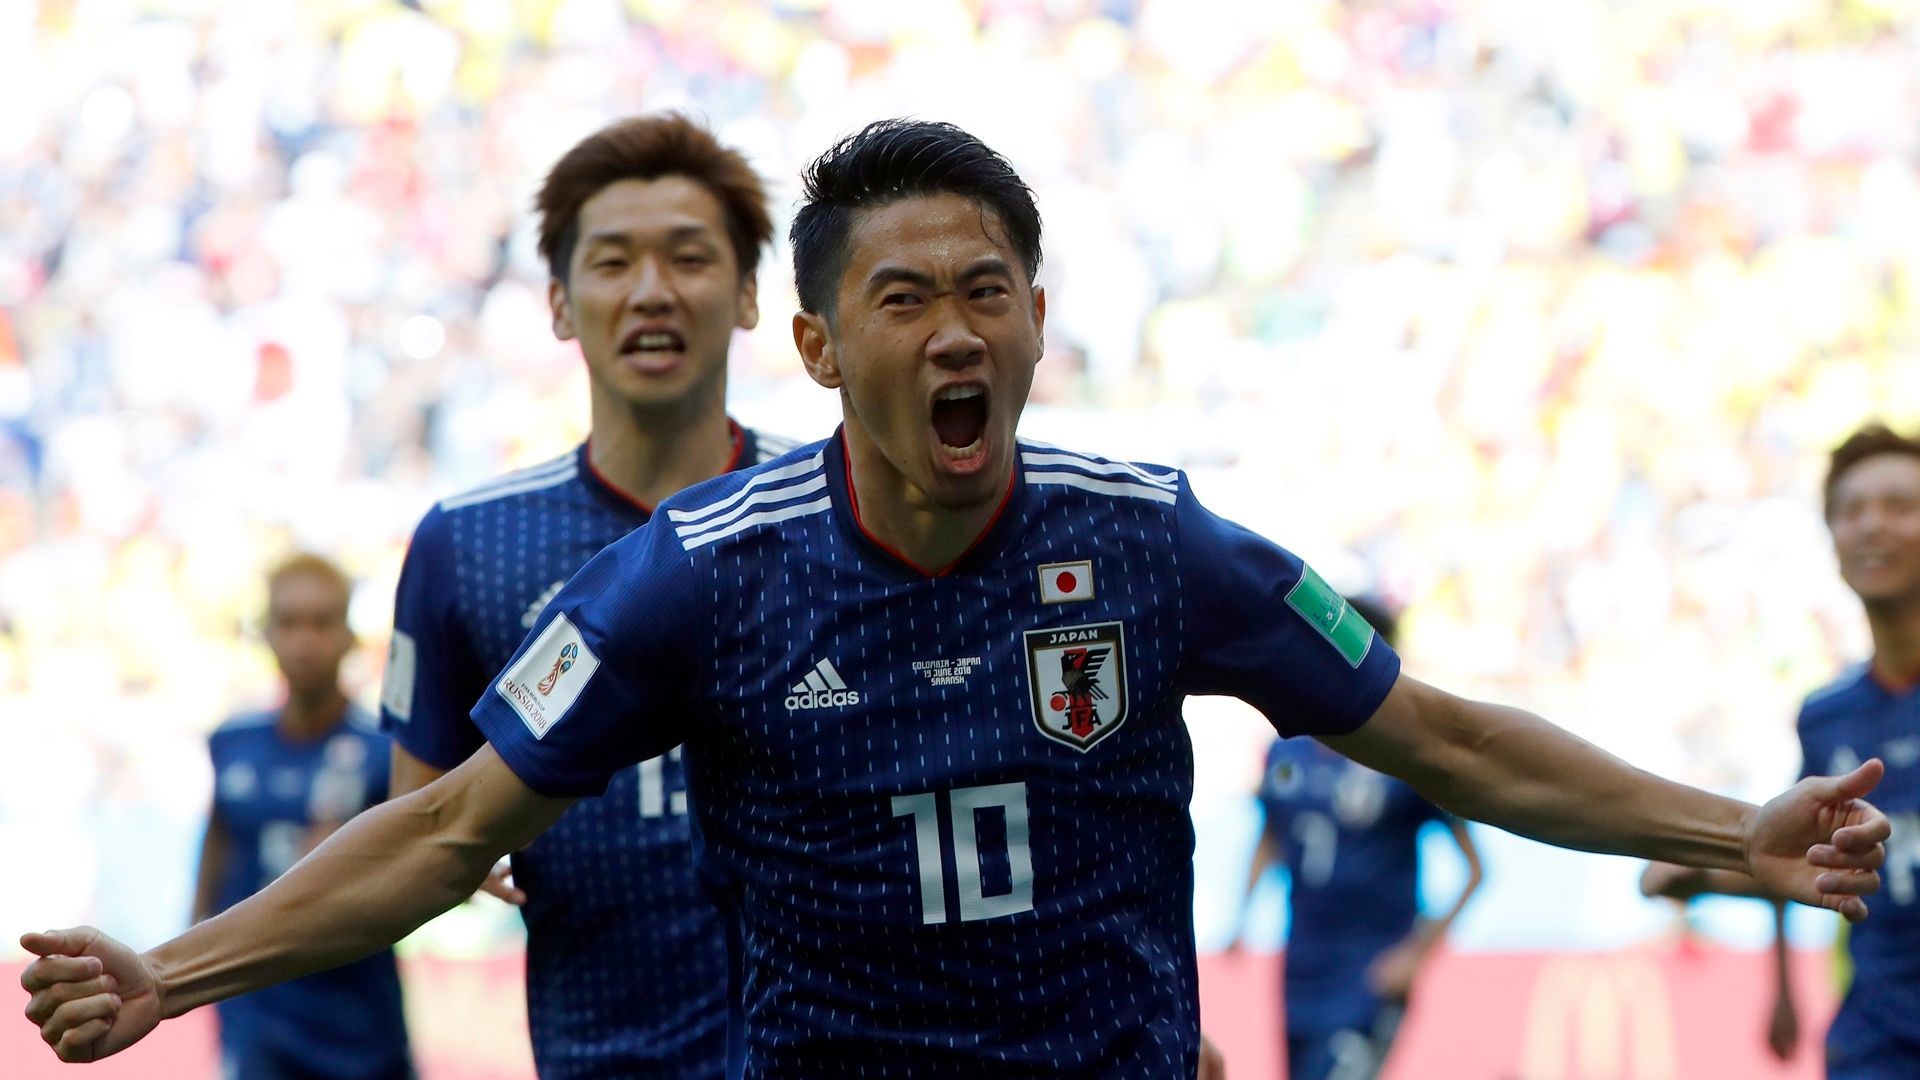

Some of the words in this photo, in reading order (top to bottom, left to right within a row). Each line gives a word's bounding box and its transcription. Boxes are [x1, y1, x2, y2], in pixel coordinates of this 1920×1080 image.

[1049, 629, 1099, 644] JAPAN
[912, 659, 950, 670] COLOMBIA
[956, 657, 981, 667] JAPAN
[923, 669, 931, 678] 19
[933, 667, 952, 677] JUNE
[953, 666, 971, 676] 2018
[931, 676, 965, 686] SARANSK
[503, 678, 534, 712] RUSSIA
[530, 709, 547, 729] 2018
[784, 688, 860, 710] adidas
[890, 781, 1035, 926] 10
